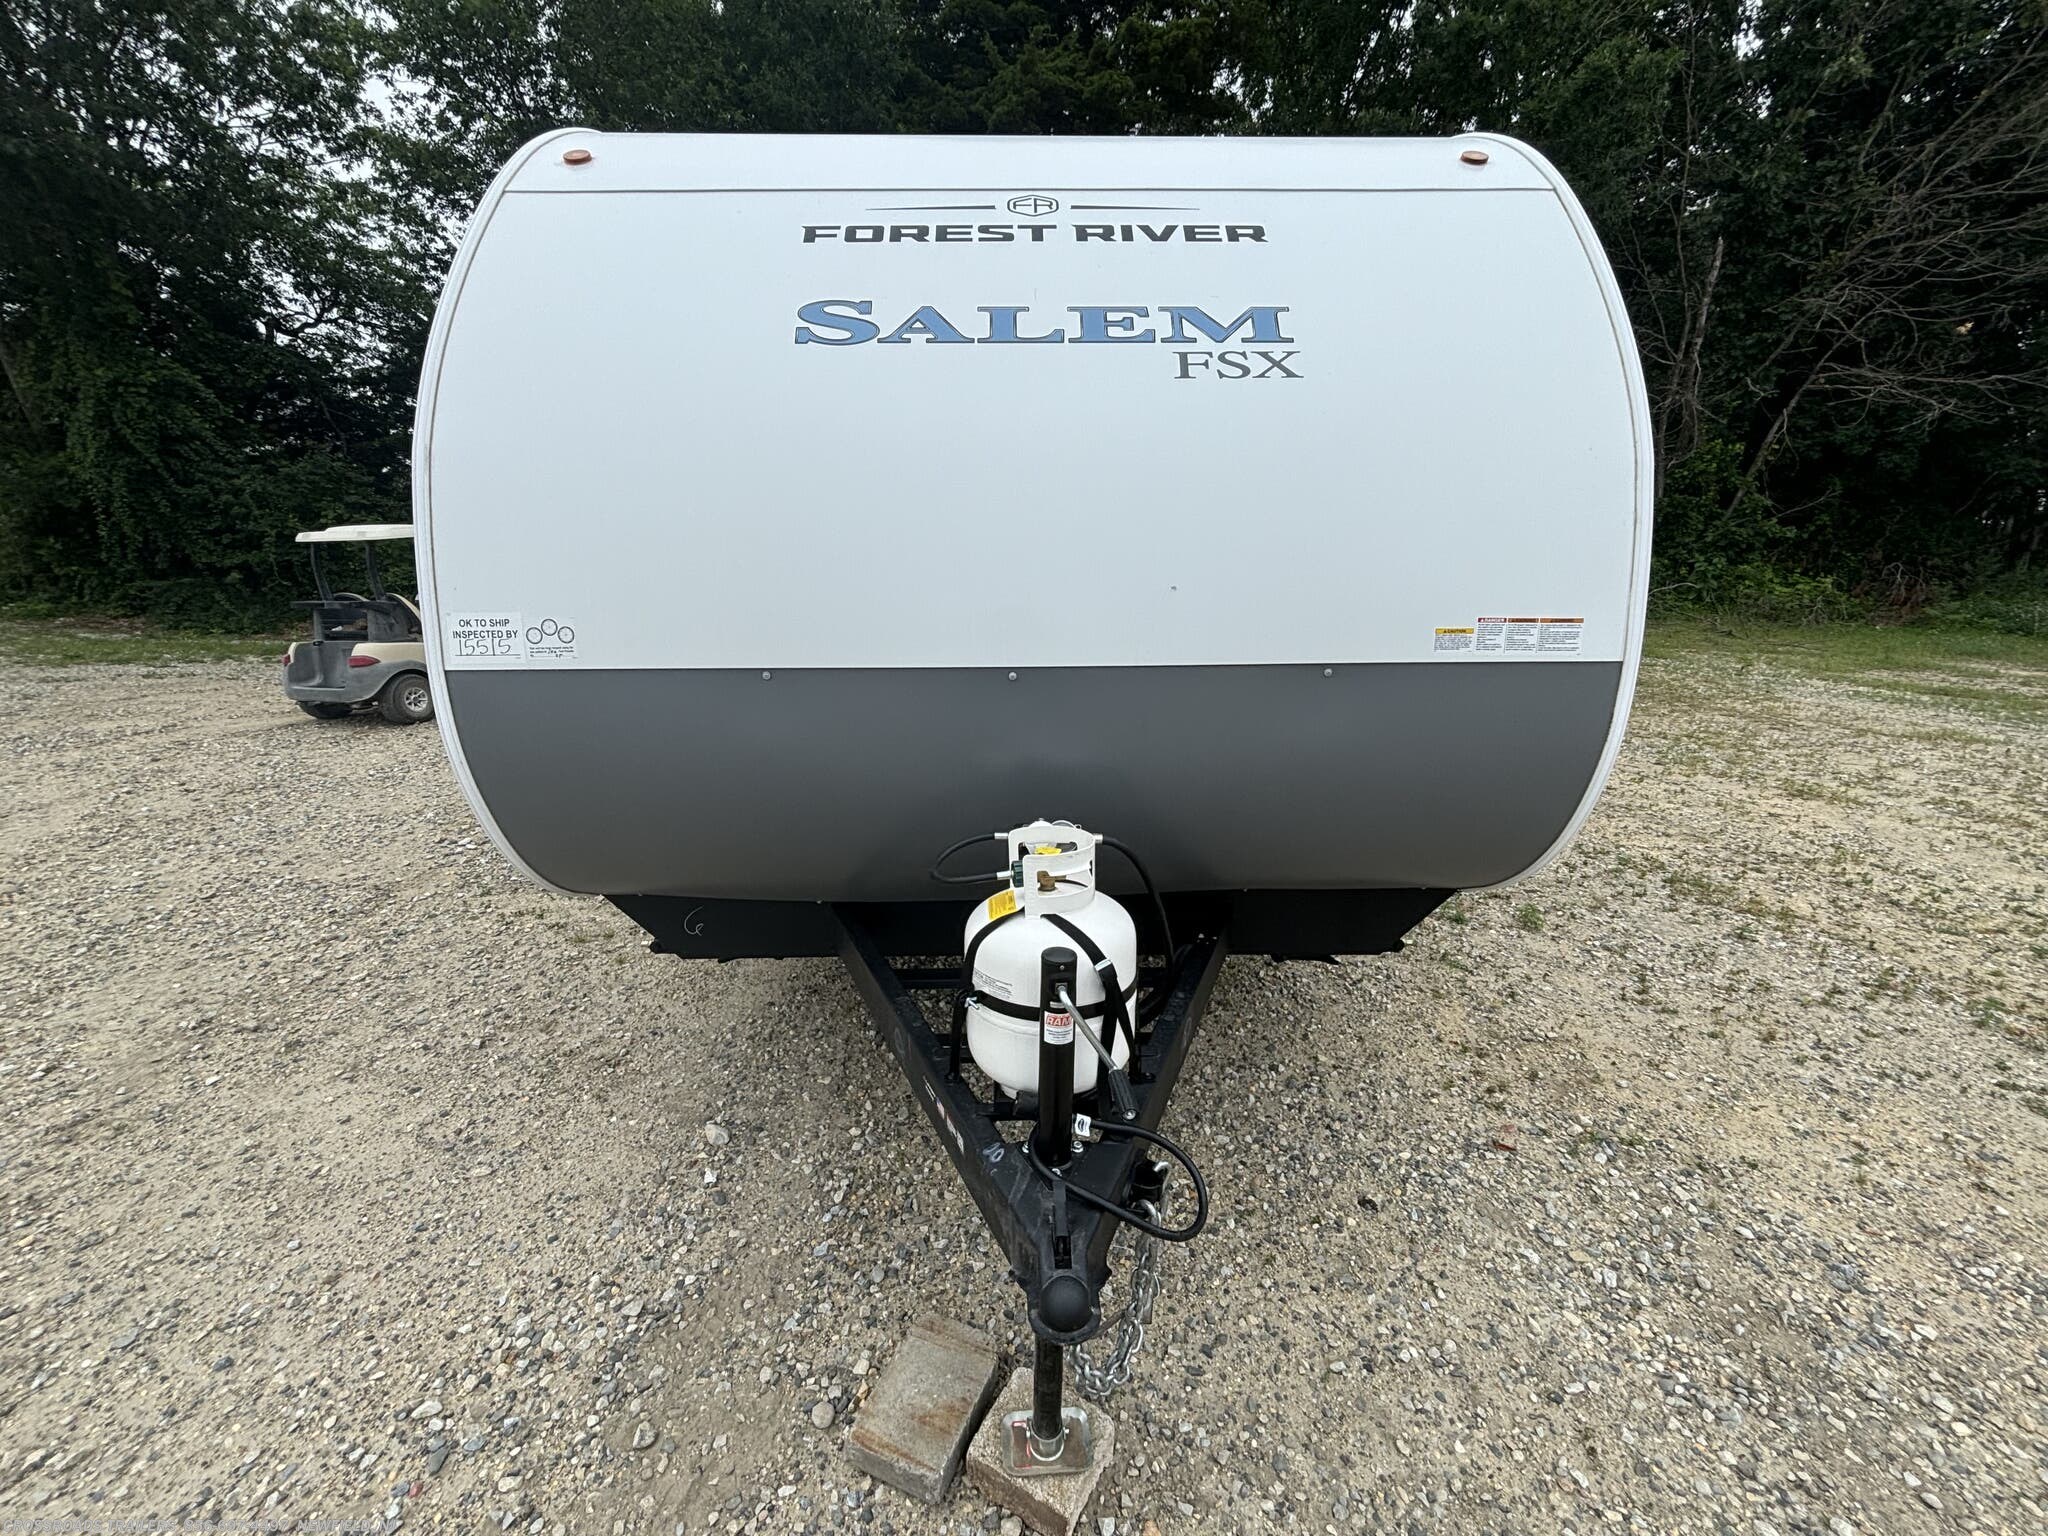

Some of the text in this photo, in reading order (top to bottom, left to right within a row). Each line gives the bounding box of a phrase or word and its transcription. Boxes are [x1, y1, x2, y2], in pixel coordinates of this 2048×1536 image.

[802, 224, 1269, 244] FOREST RIVER
[795, 300, 1295, 346] SALEM
[1173, 351, 1305, 380] FSX
[458, 618, 510, 628] OK TO SHIP
[453, 630, 519, 639] INSPECTED BY
[458, 638, 511, 656] 15515
[1045, 1013, 1073, 1027] RAM
